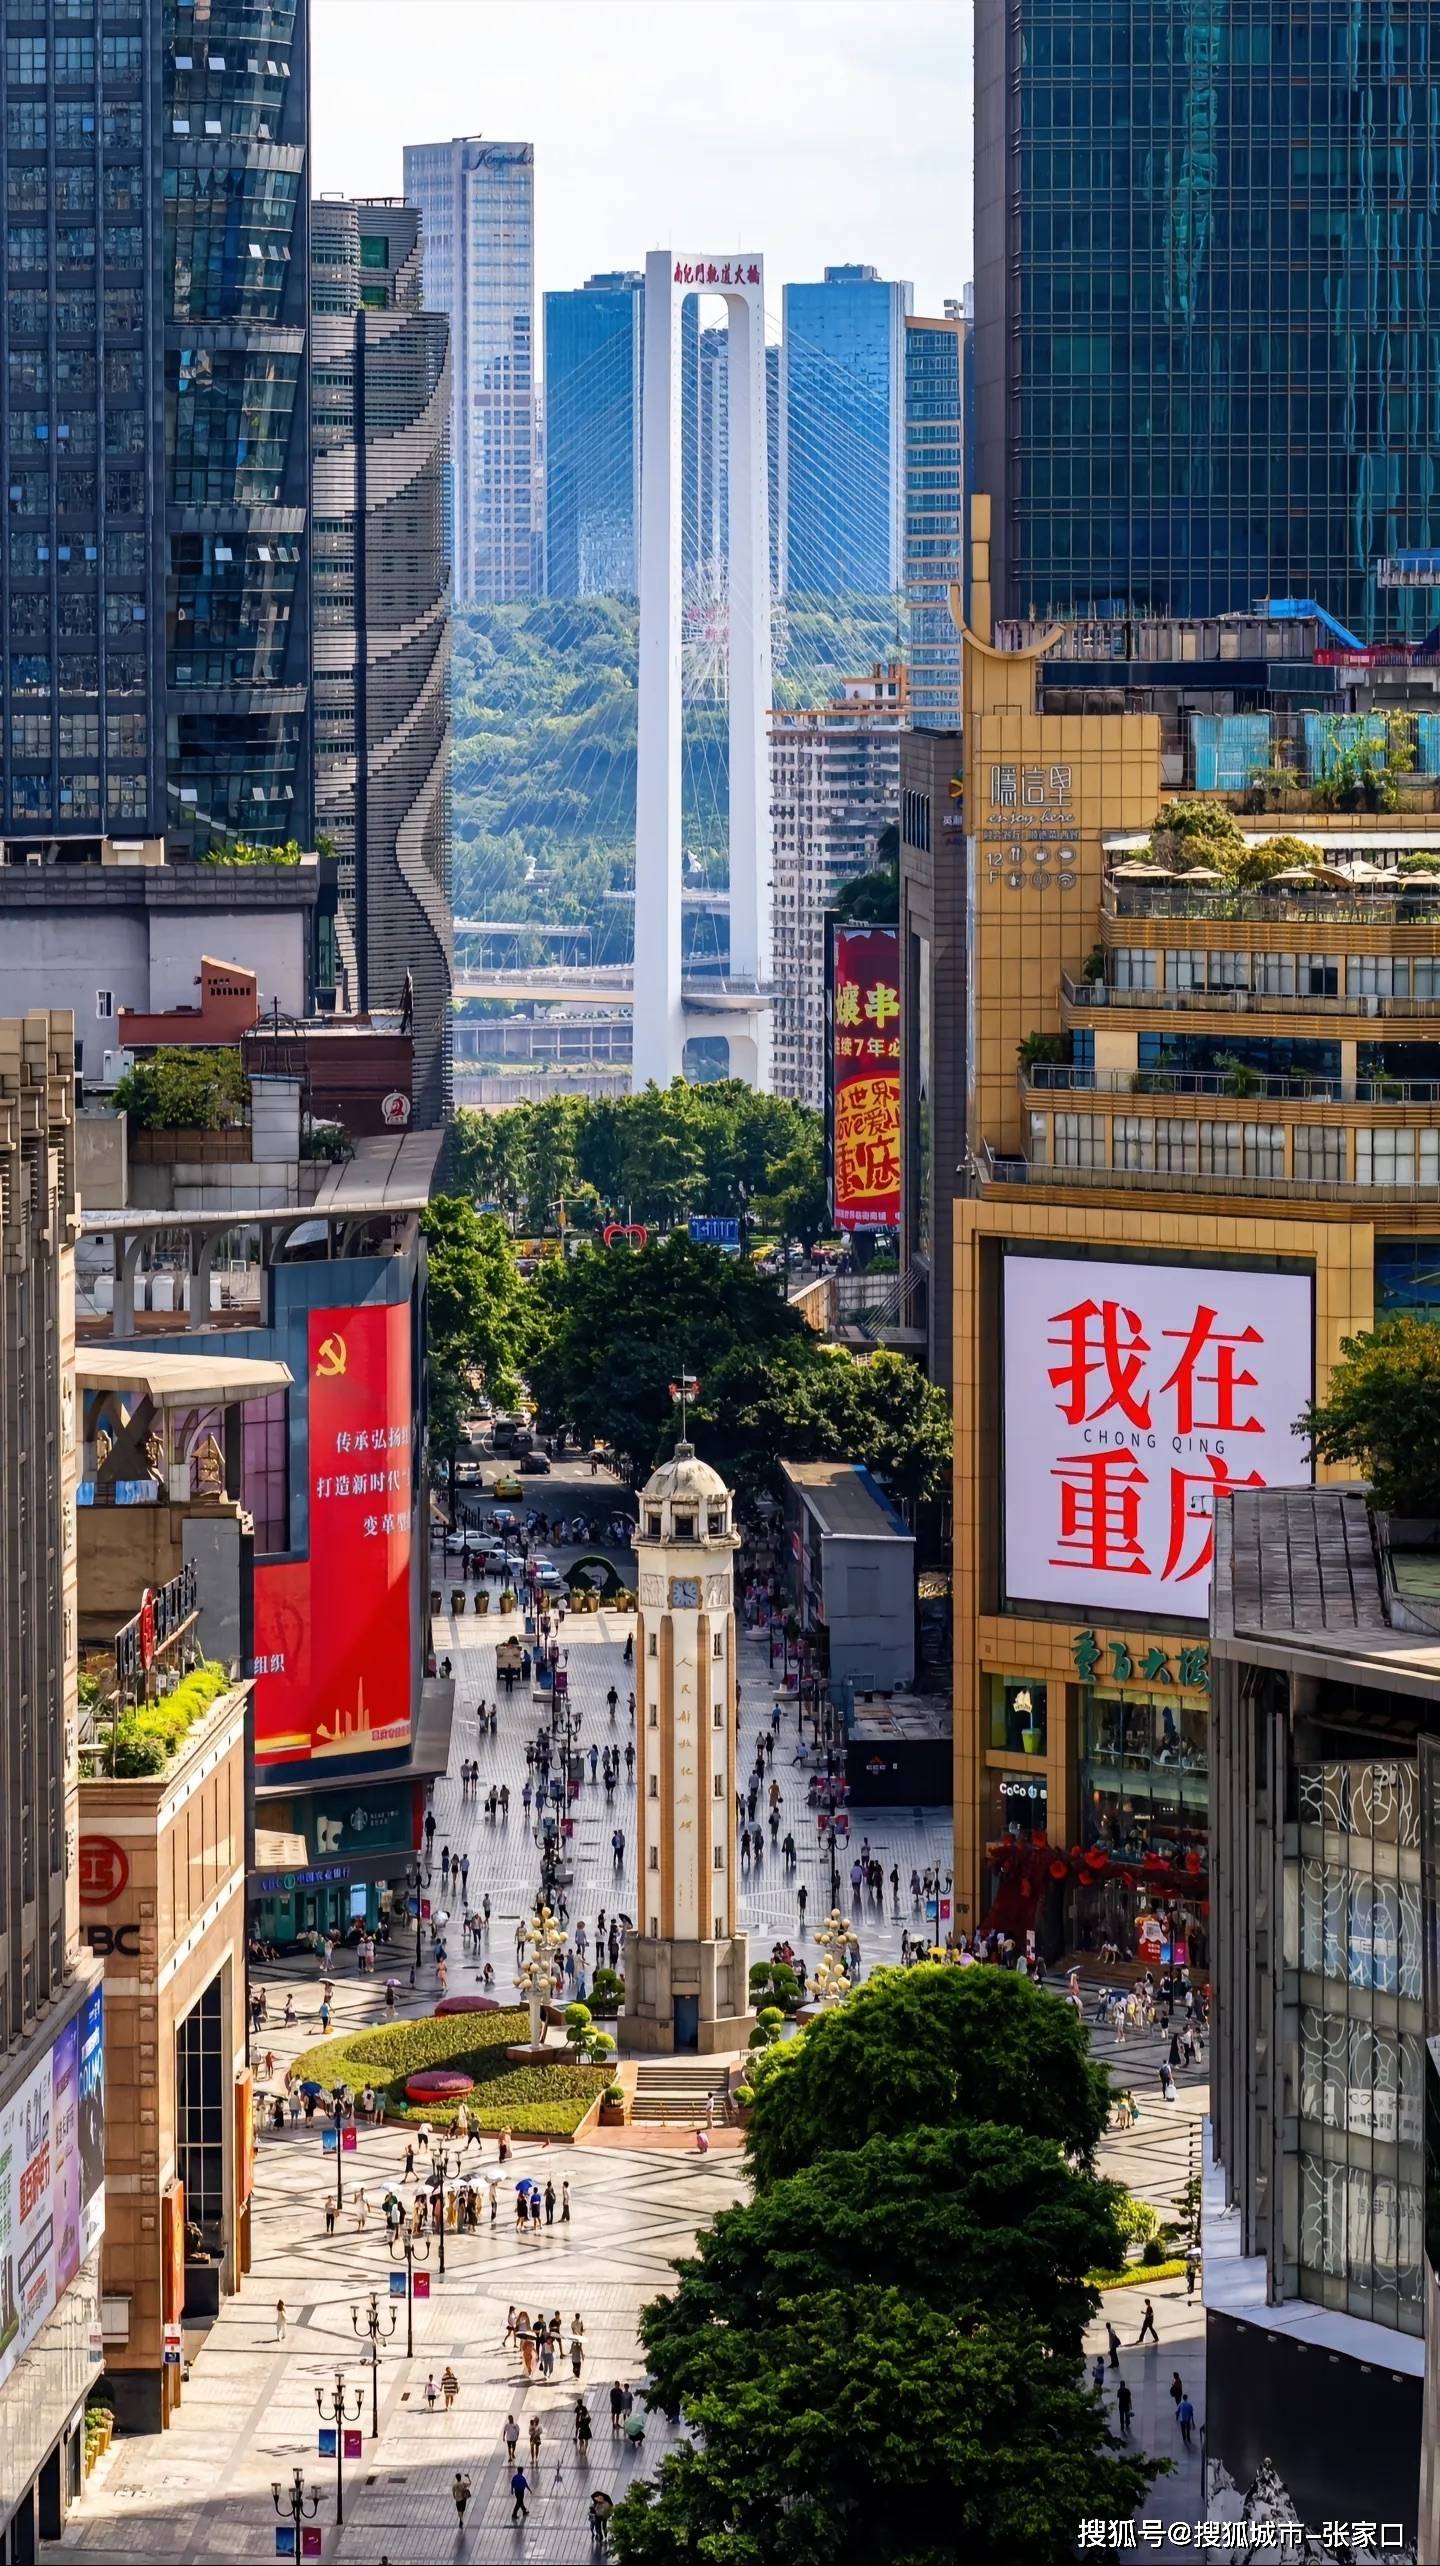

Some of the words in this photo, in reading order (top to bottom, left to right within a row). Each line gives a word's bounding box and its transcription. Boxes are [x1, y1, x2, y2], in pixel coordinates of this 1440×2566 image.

[988, 812, 1035, 828] enjoy
[1040, 808, 1075, 825] here
[986, 852, 1003, 867] 12
[989, 870, 999, 884] F
[1047, 1297, 1266, 1436] 我在
[1084, 1428, 1157, 1450] CHONG
[1172, 1435, 1227, 1455] QING
[79, 1925, 141, 1956] BC
